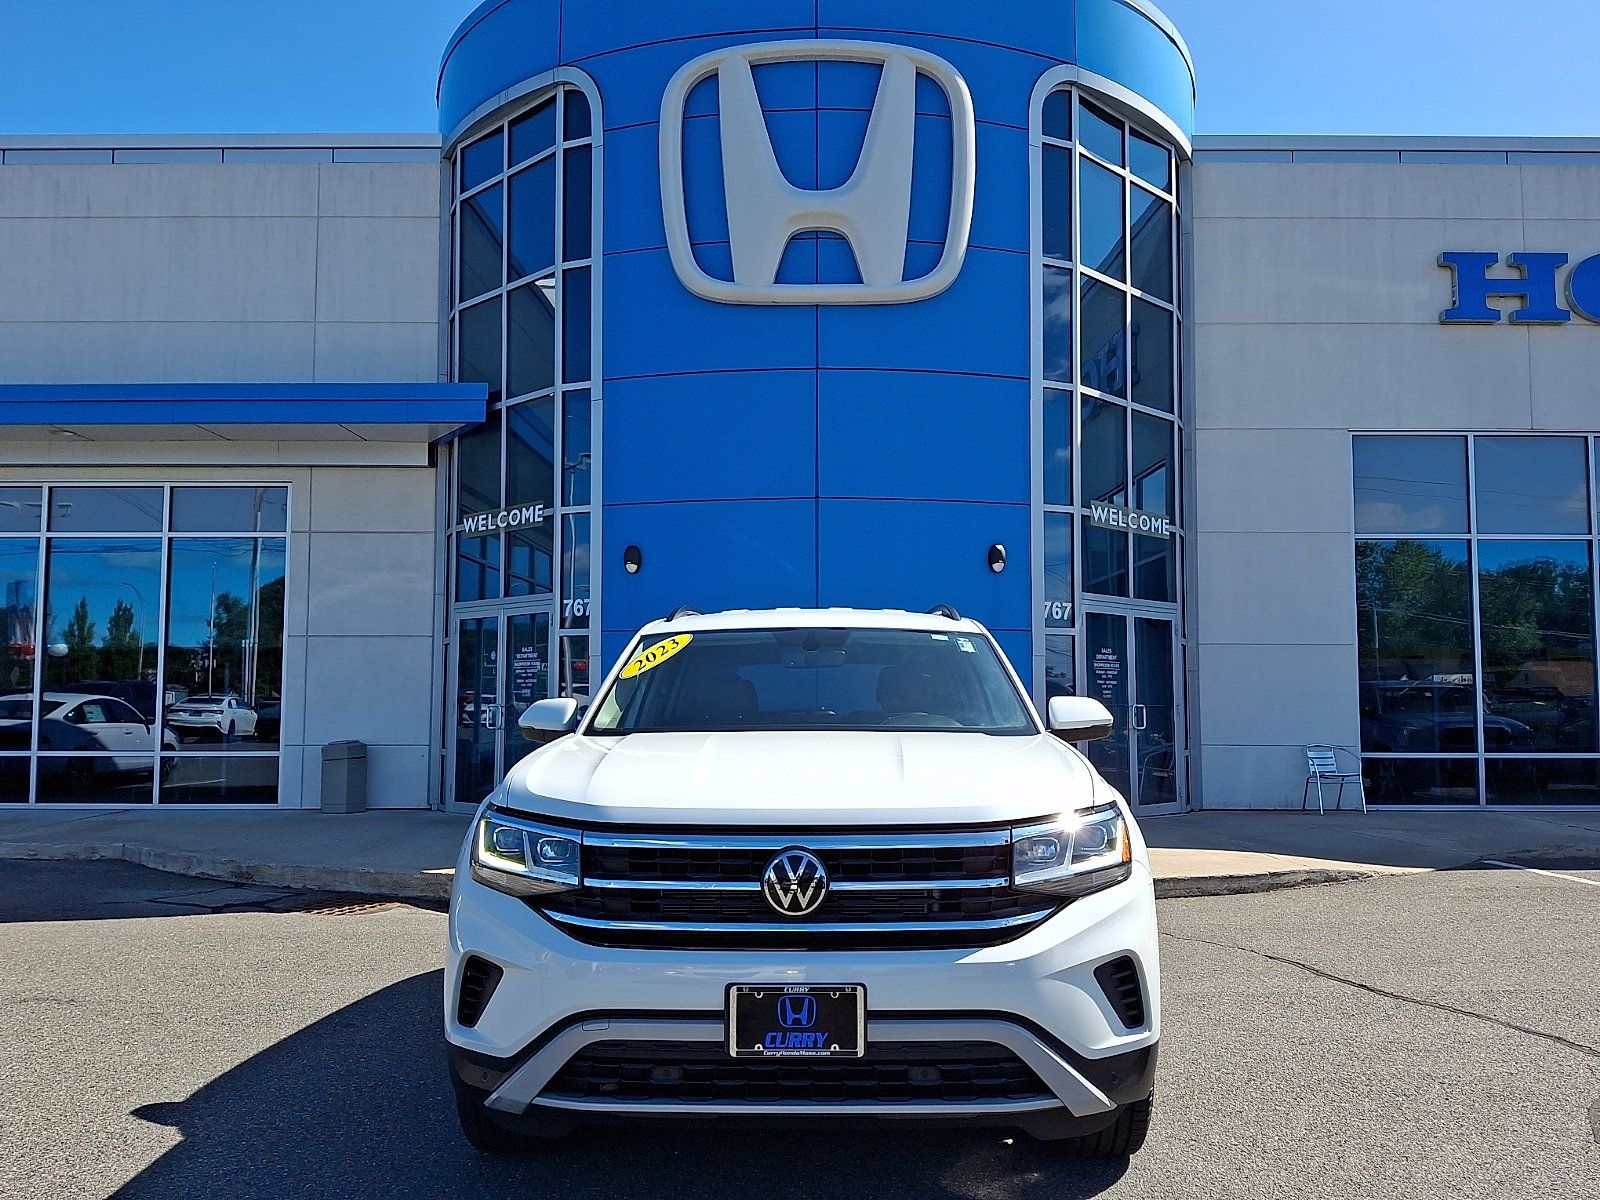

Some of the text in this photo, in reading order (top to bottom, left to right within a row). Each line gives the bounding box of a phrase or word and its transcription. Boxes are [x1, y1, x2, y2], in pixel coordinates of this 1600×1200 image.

[463, 504, 544, 533] WELCOME
[1091, 504, 1170, 535] WELCOME
[563, 599, 590, 616] 767
[1044, 602, 1072, 620] 767
[634, 639, 680, 671] 2023
[764, 1032, 829, 1048] CURRY
